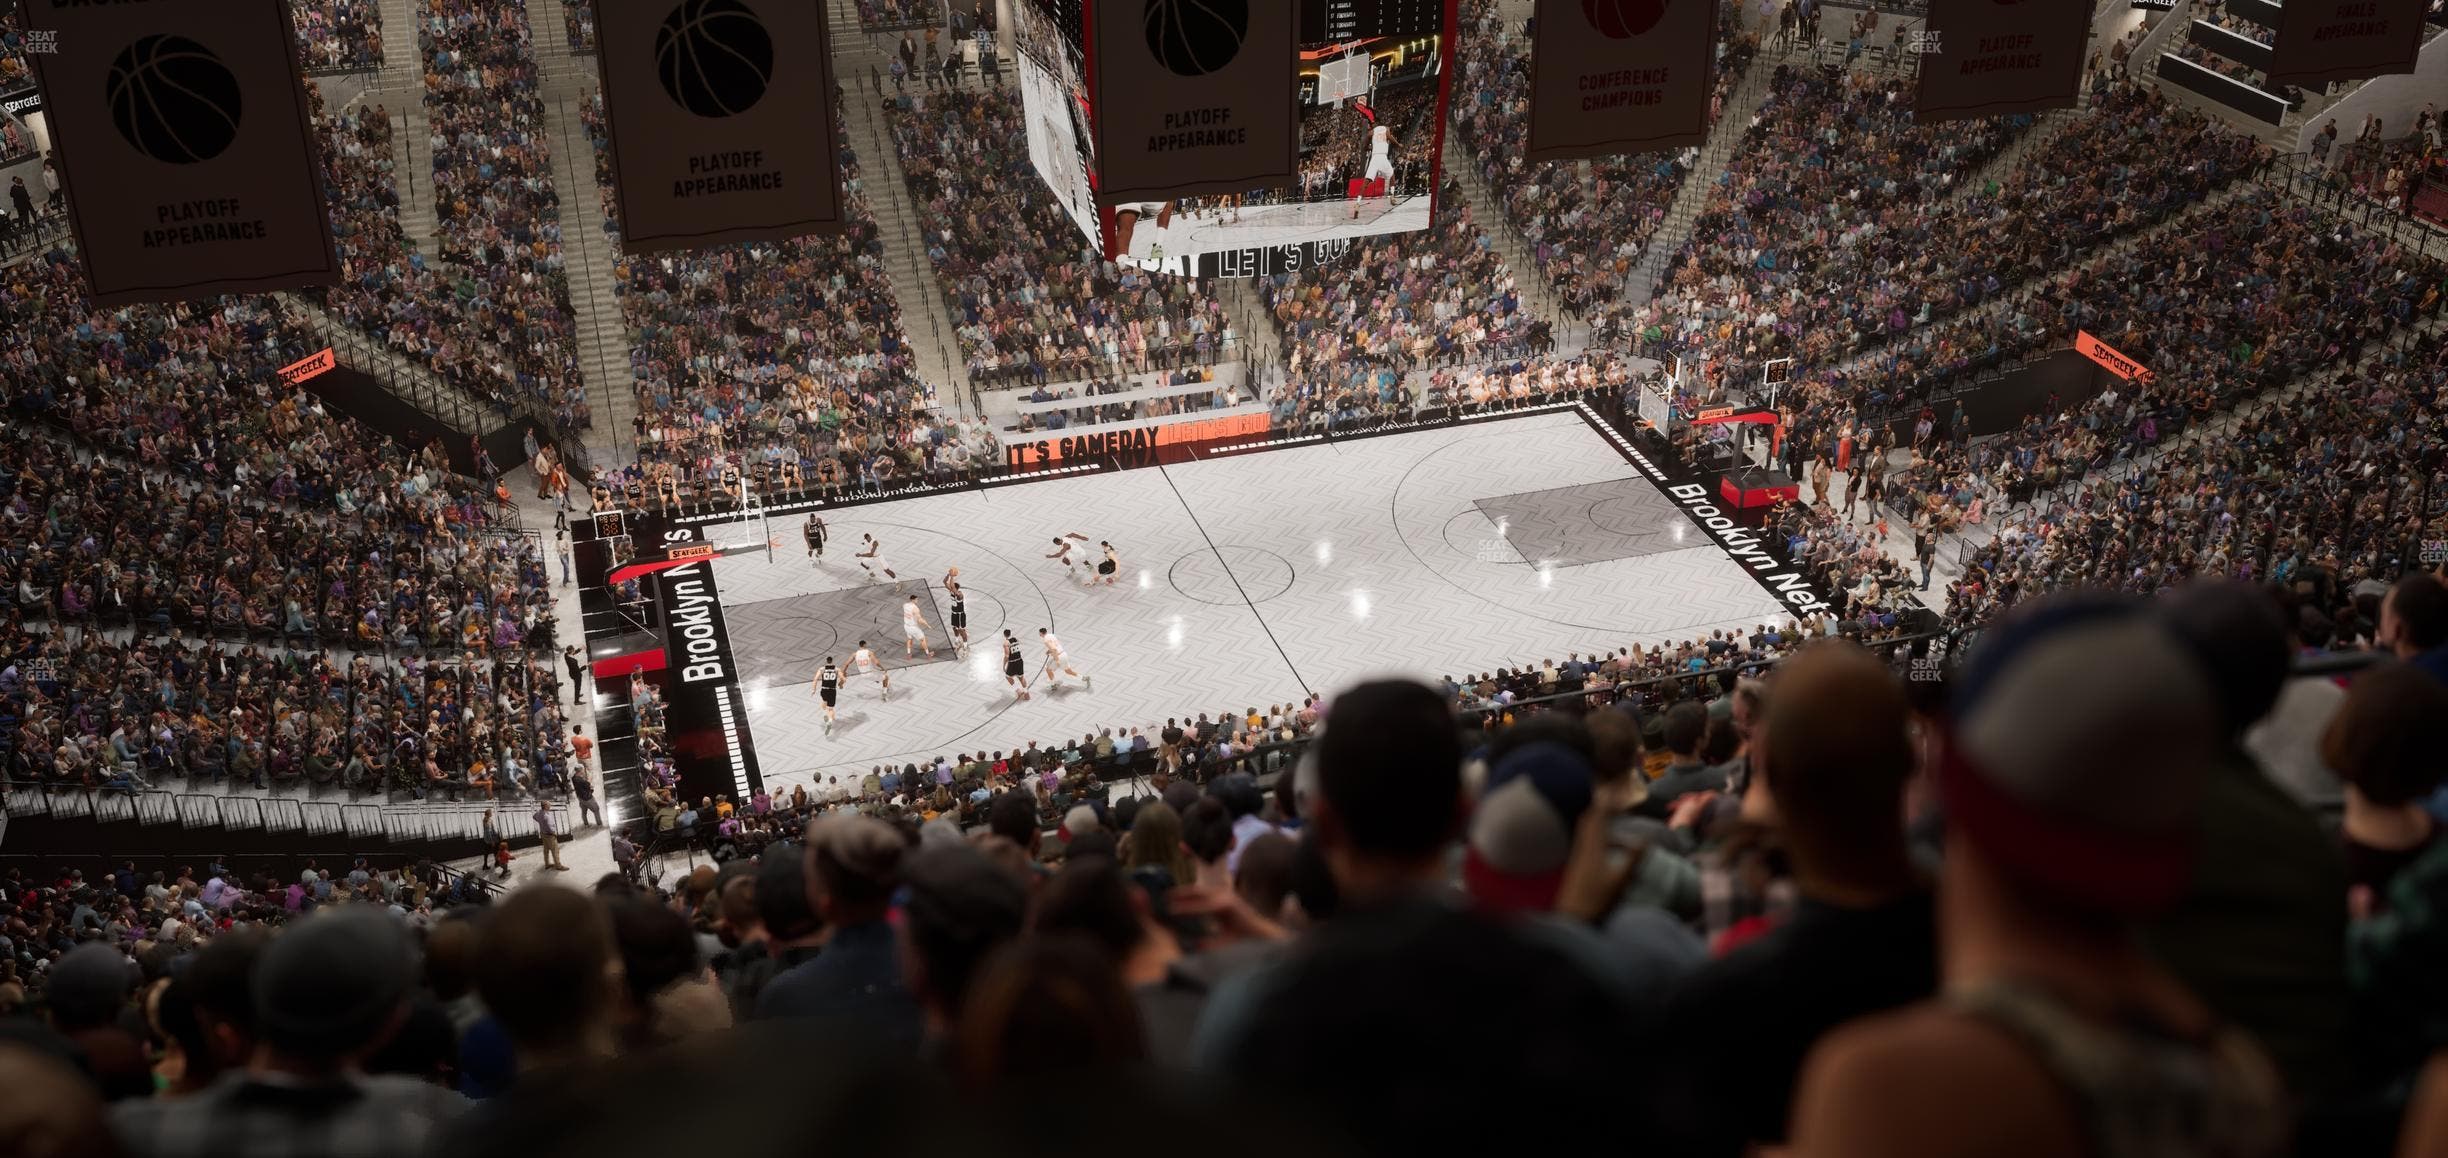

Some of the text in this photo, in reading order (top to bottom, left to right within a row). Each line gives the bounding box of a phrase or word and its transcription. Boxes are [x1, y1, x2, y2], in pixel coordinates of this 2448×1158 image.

[2337, 3, 2377, 18] FINALS
[2312, 19, 2388, 41] APPEARANCE
[1979, 34, 2033, 54] PLAYOFF
[1960, 54, 2042, 74] APPEARANCE
[1579, 67, 1668, 90] CONFERENCE
[1582, 89, 1663, 111] CHAMPIONS
[1165, 108, 1230, 130] PLAYOFF
[1148, 127, 1246, 152] APPEARANCE
[690, 151, 763, 174] PLAYOFF
[674, 171, 781, 198] APPEARANCE
[157, 198, 240, 223] PLAYOFF
[143, 220, 266, 248] APPEARANCE
[1218, 243, 1302, 279] LET'S
[2093, 344, 2138, 378] SEATGEEK
[1006, 440, 1050, 466] IT'S
[1060, 426, 1159, 458] GAMEDAY
[1668, 483, 1779, 570] Brooklyn
[673, 547, 709, 558] SEATGEEK
[660, 529, 724, 683] Brooklyn Ns
